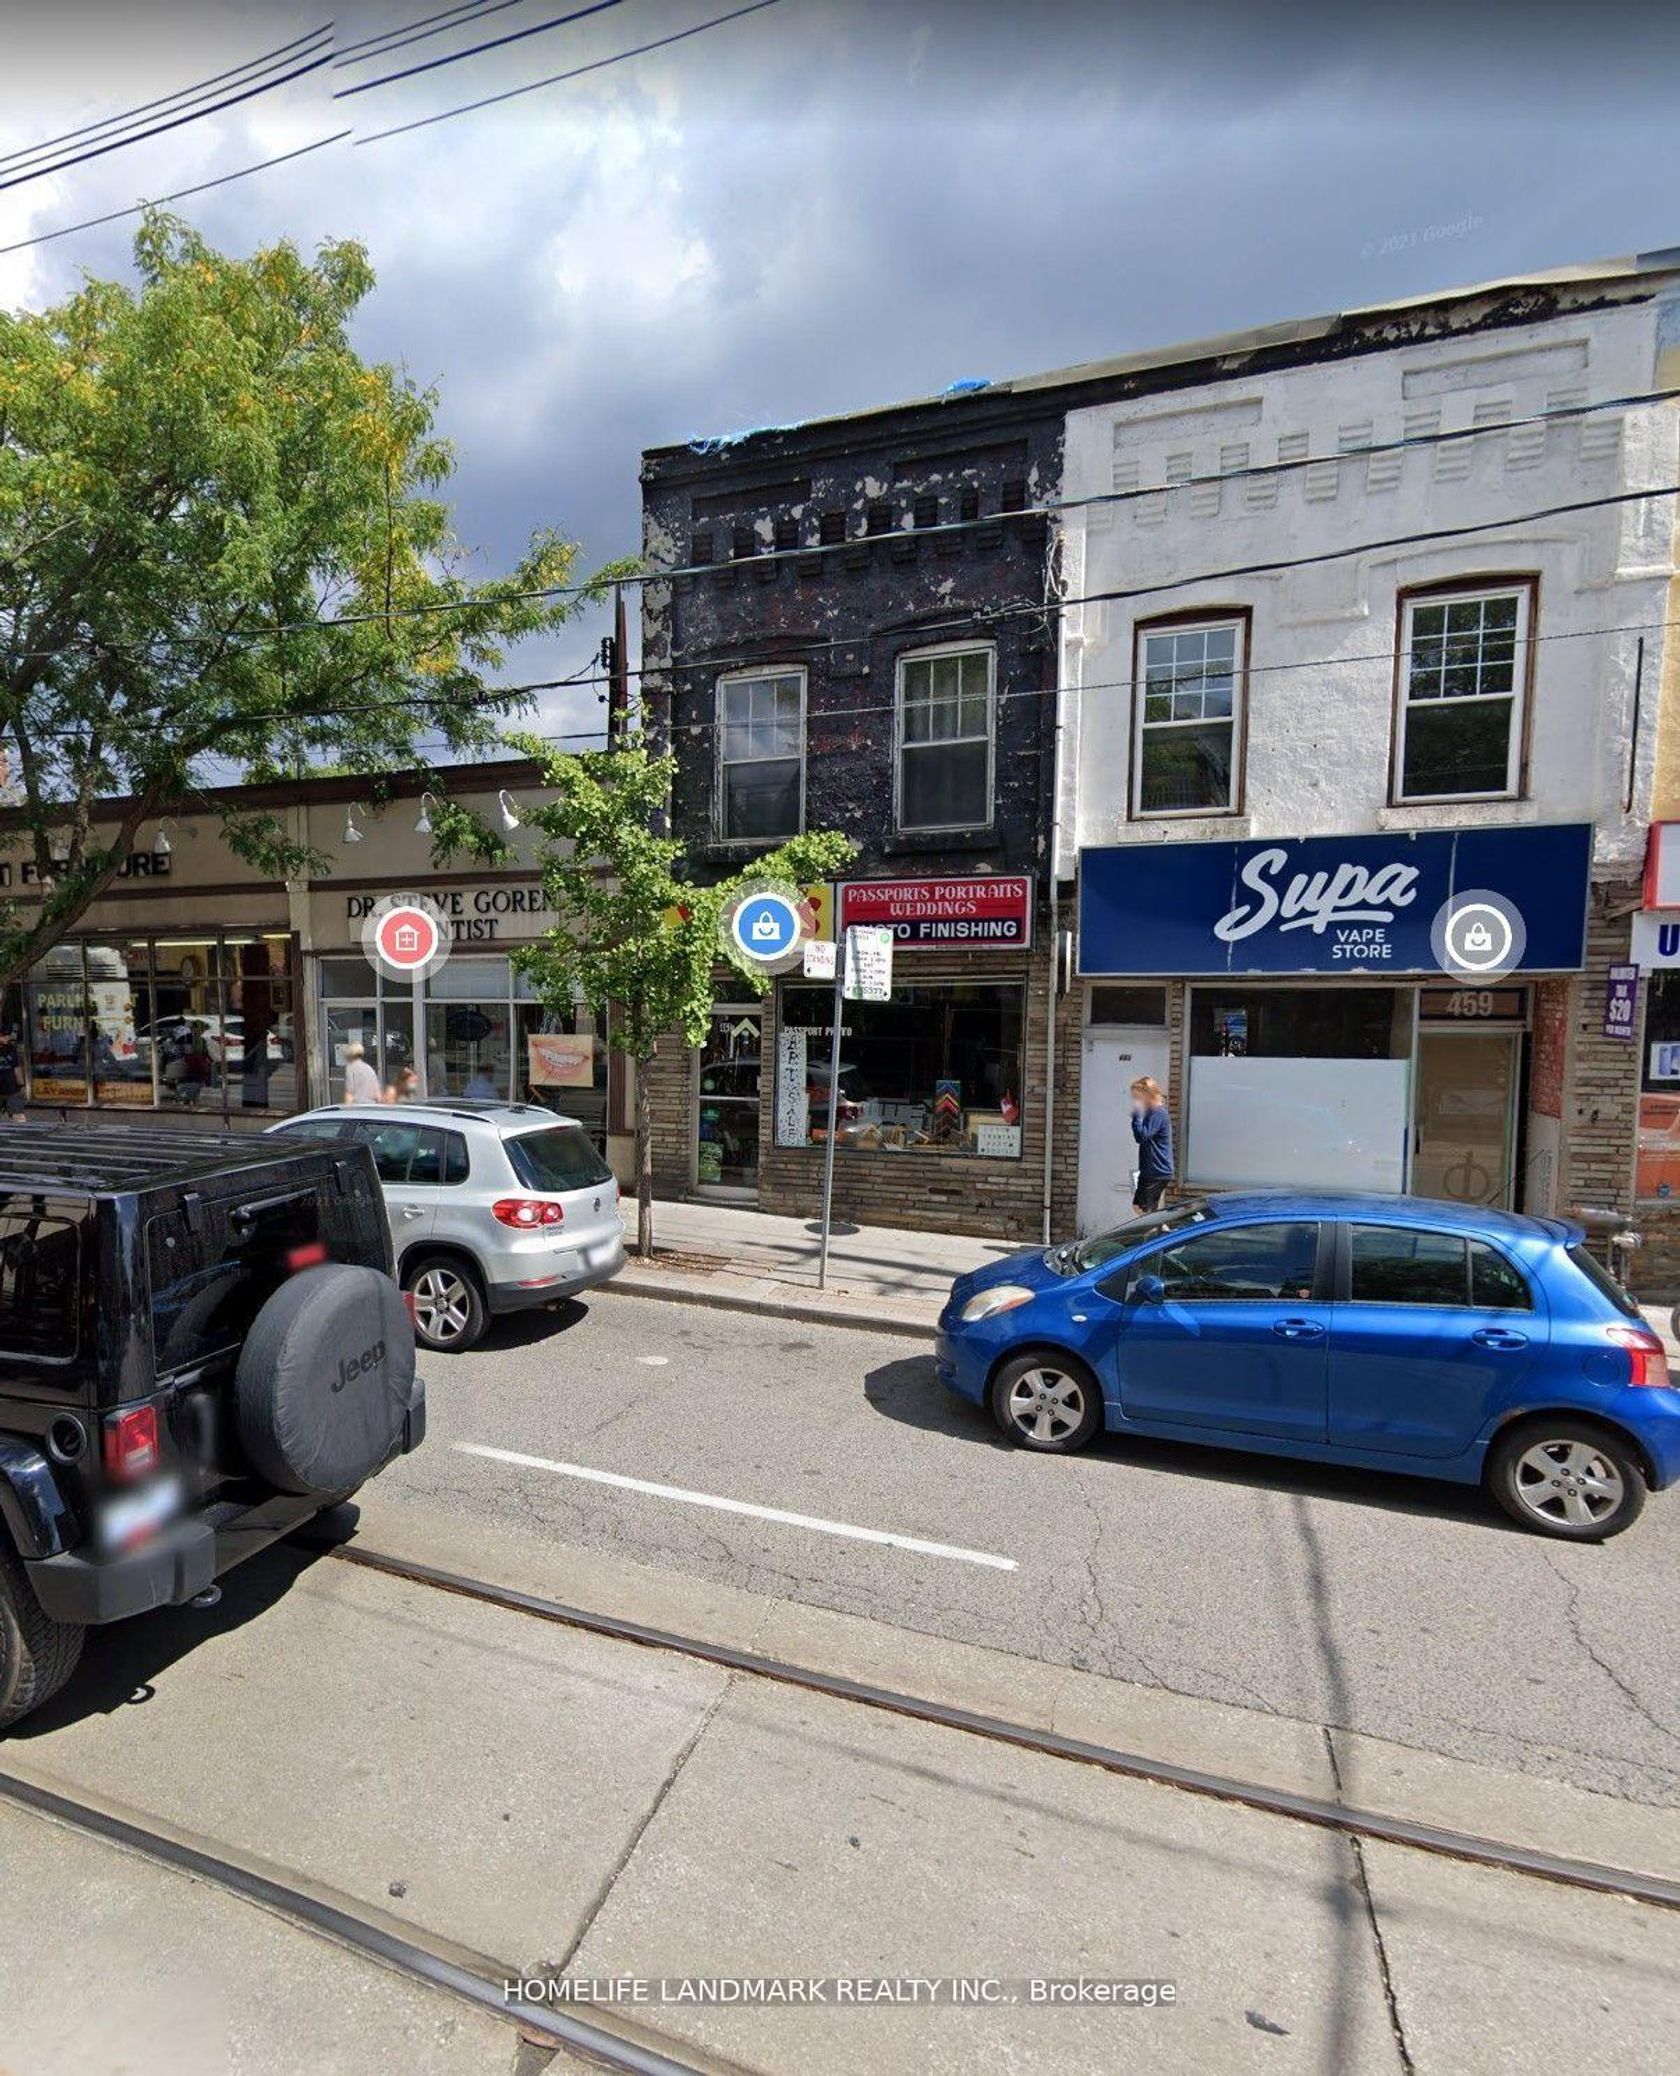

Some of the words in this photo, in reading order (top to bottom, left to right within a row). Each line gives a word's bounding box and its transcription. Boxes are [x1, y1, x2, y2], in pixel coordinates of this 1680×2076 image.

[848, 886, 929, 903] PASSPORTS
[935, 883, 1023, 900] PORTRAITS
[1214, 848, 1420, 942] Supa
[890, 901, 977, 916] WEDDINGS
[919, 921, 1017, 938] FINISHING
[1336, 929, 1386, 943] VAPE
[1332, 945, 1392, 959] STORE
[330, 1340, 387, 1393] Jeep
